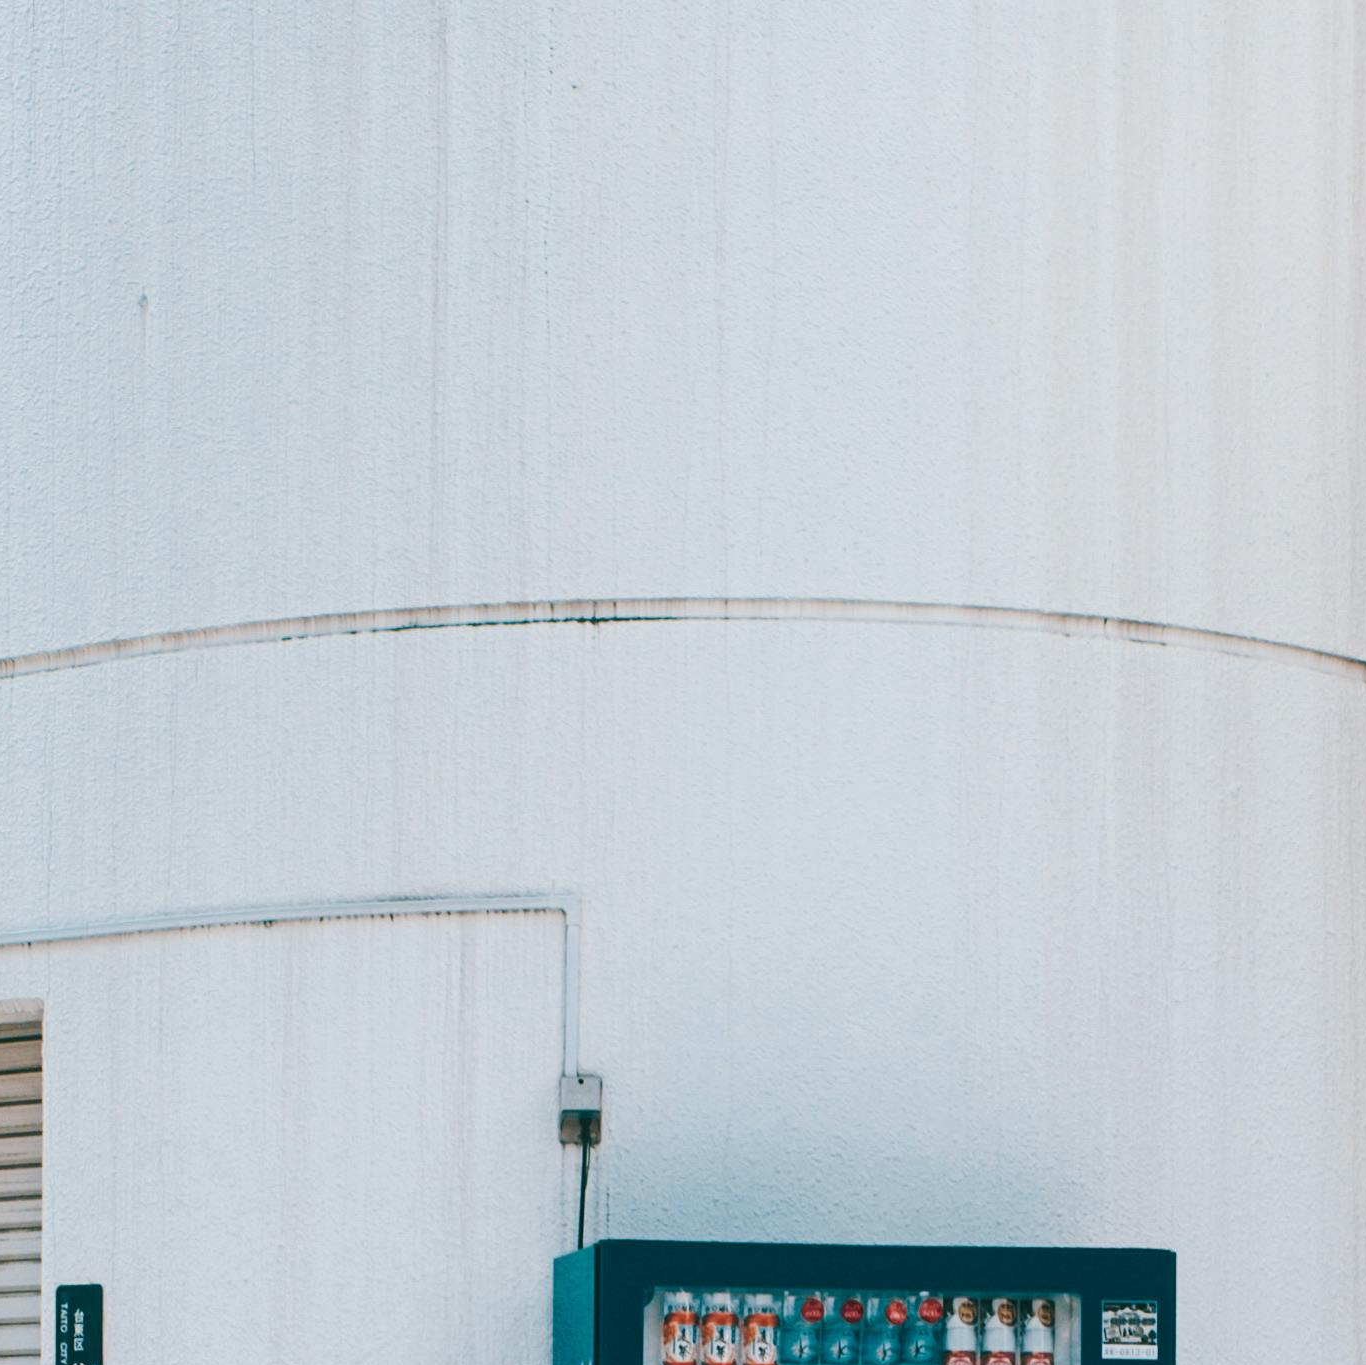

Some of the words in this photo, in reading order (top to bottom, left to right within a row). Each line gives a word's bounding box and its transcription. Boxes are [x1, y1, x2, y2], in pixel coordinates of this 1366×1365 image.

[60, 1302, 69, 1333] TAITO
[73, 1308, 85, 1351] 台東区
[59, 1342, 68, 1365] CITY
